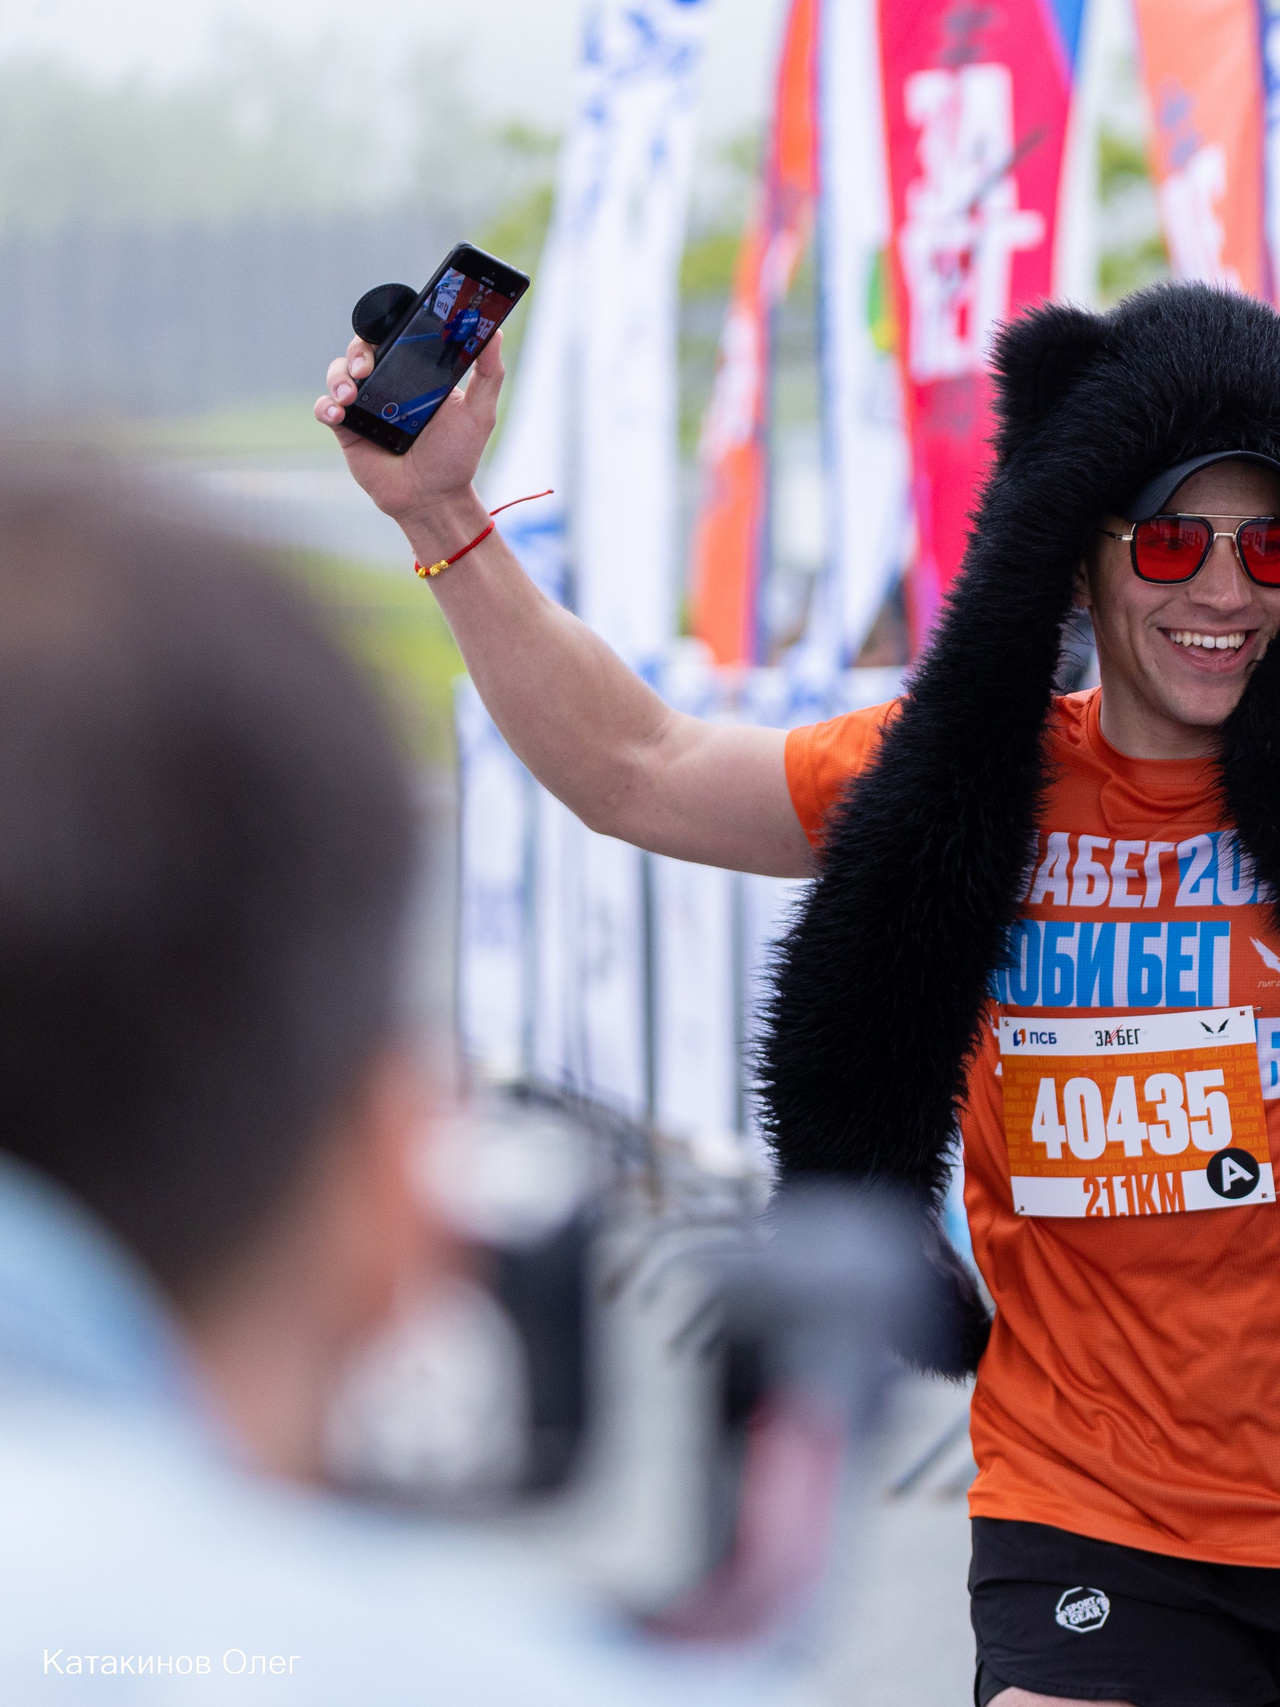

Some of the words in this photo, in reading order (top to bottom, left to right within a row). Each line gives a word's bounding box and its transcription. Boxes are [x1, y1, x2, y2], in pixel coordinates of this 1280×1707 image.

[1016, 830, 1178, 907] АБЕГ
[988, 919, 1117, 1007] ЮБИ
[1127, 921, 1230, 1007] БЕГ
[1030, 1031, 1058, 1045] ПСБ
[1032, 1069, 1232, 1159] 40435
[1065, 1596, 1096, 1614] SPORT
[1069, 1606, 1102, 1624] GEAR
